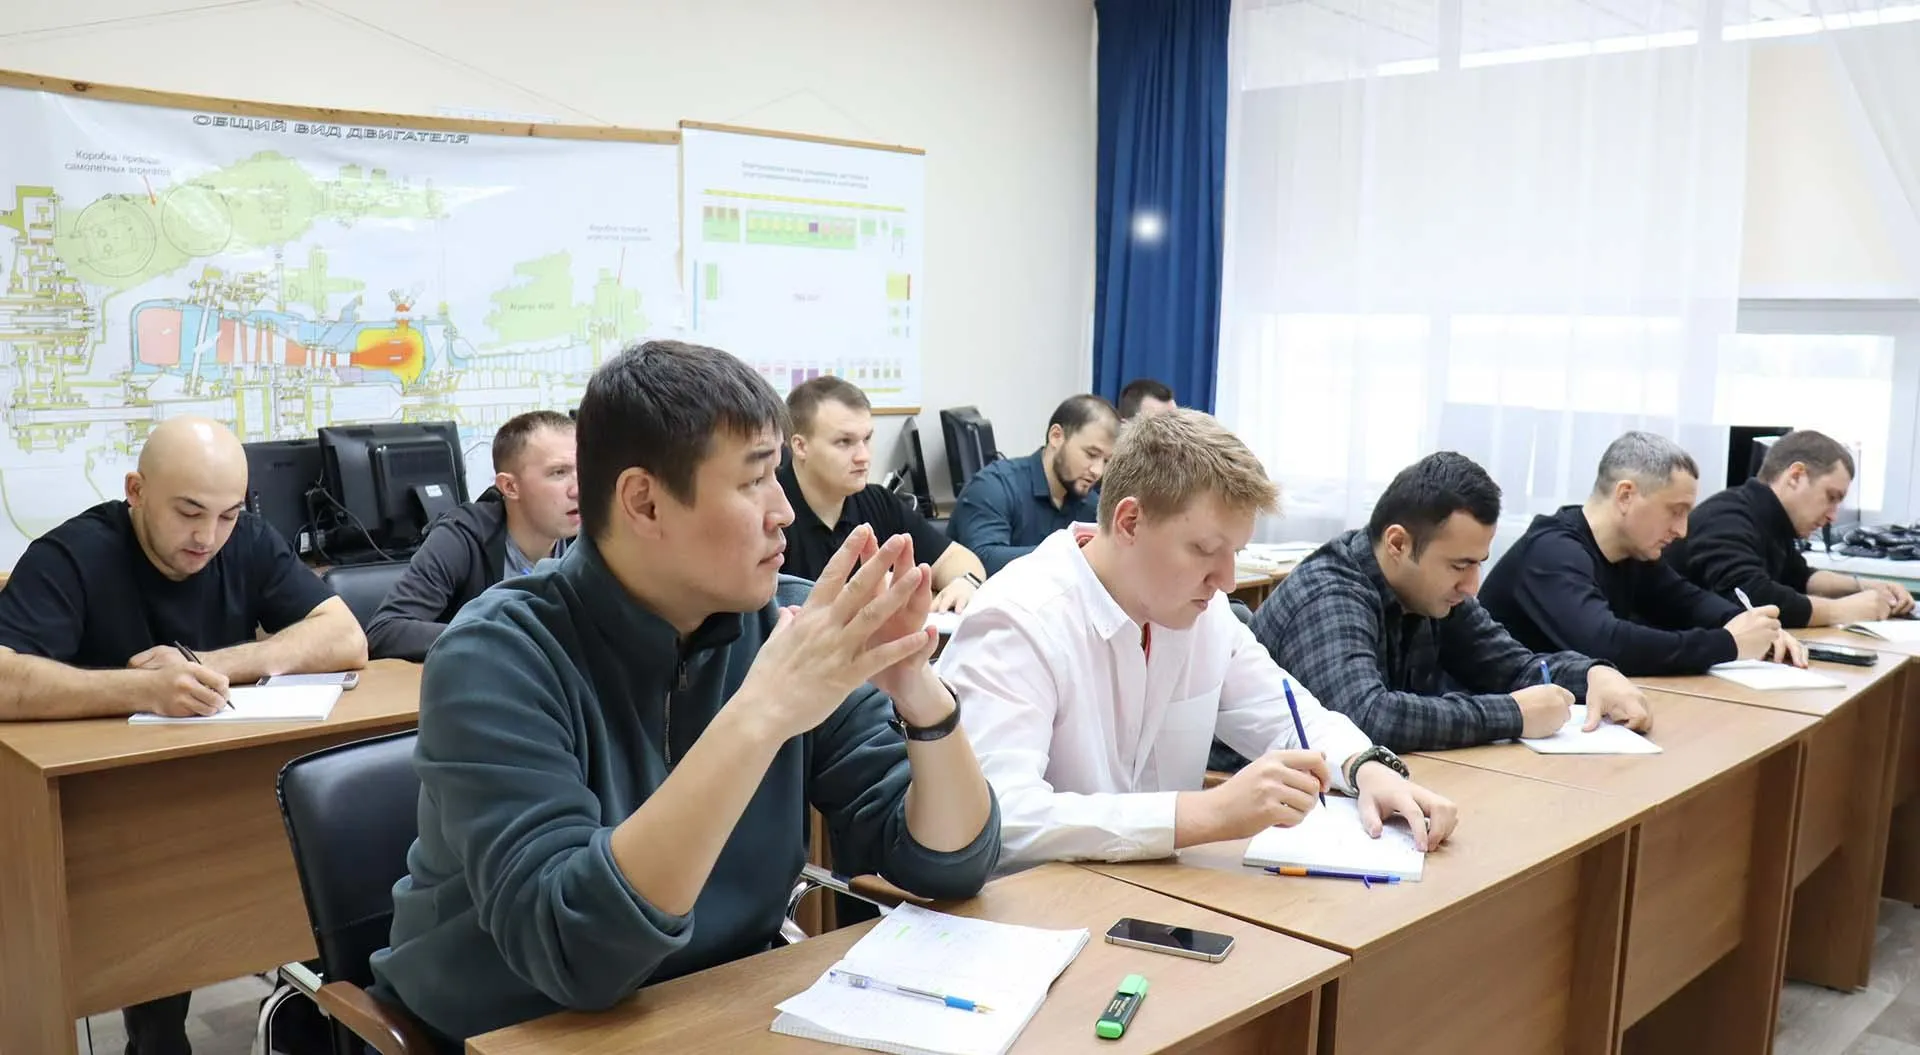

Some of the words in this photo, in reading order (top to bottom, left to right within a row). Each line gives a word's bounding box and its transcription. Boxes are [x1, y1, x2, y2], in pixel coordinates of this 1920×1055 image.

[192, 114, 288, 133] ОБЩИЙ
[294, 120, 342, 138] ВИД
[346, 127, 470, 144] ДВИГАТЕЛЯ
